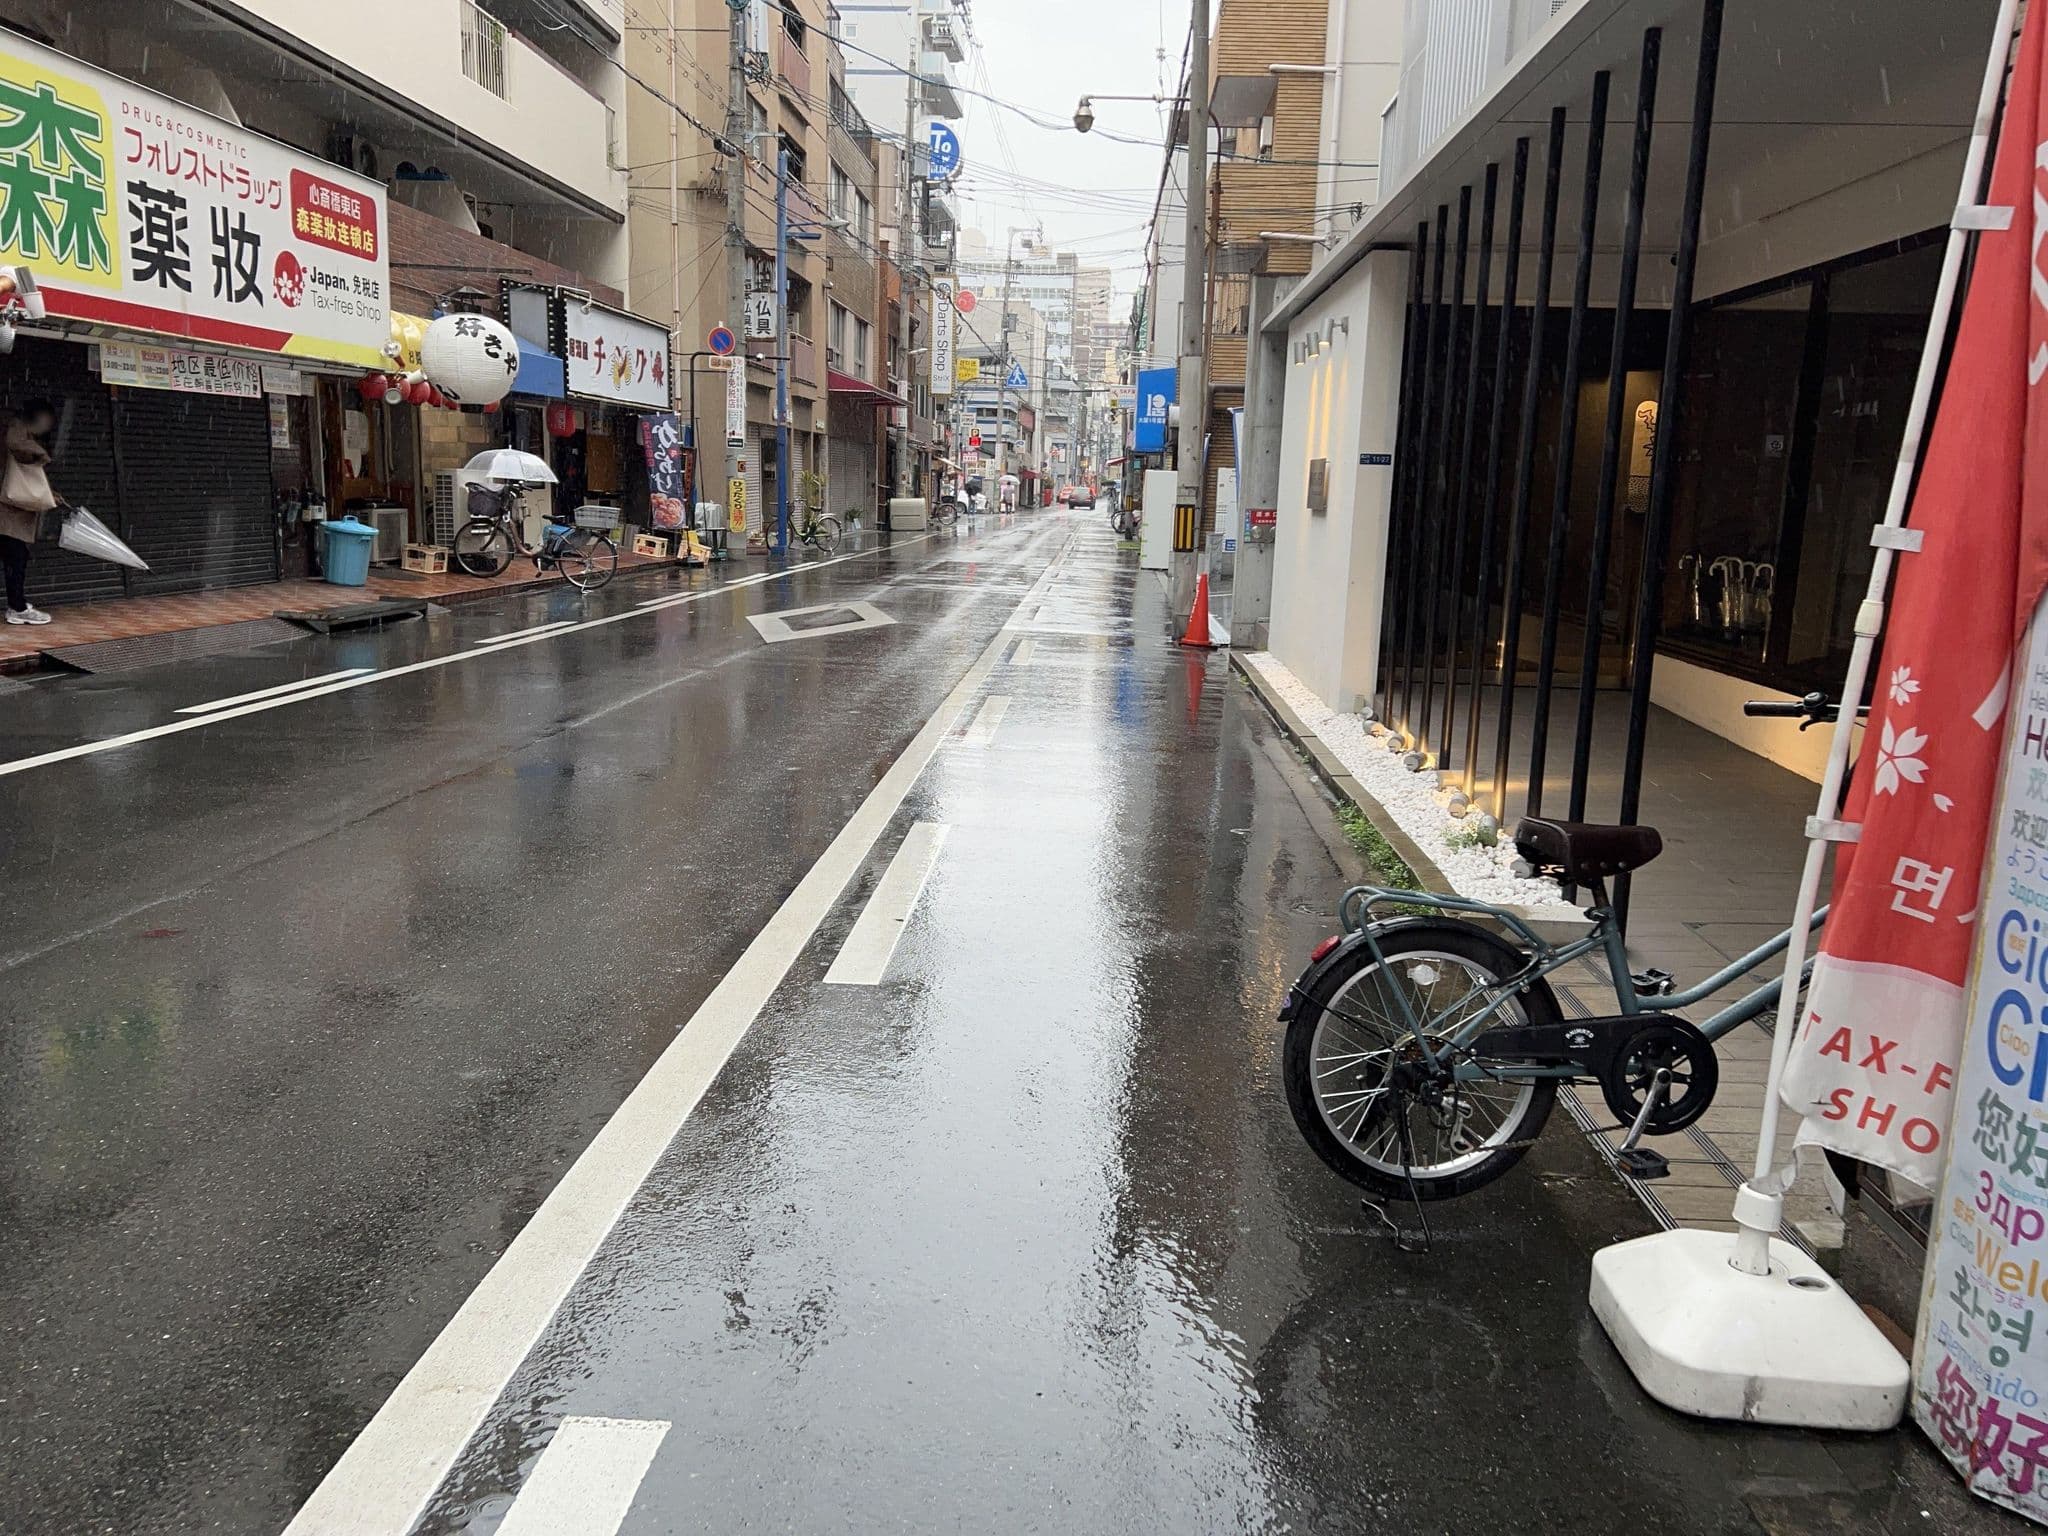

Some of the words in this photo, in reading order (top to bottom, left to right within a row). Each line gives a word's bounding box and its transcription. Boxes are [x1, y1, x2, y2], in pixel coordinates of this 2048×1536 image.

[122, 101, 247, 159] DRUG&COSMETIC
[0, 81, 110, 275] 森
[124, 126, 282, 210] フォレストドラッグ
[310, 290, 354, 315] Tax-free
[356, 300, 381, 323] Shop
[353, 274, 380, 300] 免税店
[938, 302, 949, 336] Darts
[171, 355, 258, 382] 地区最低价格
[936, 340, 949, 372] Shop
[2023, 714, 2048, 763] H
[1891, 856, 1975, 924] 면
